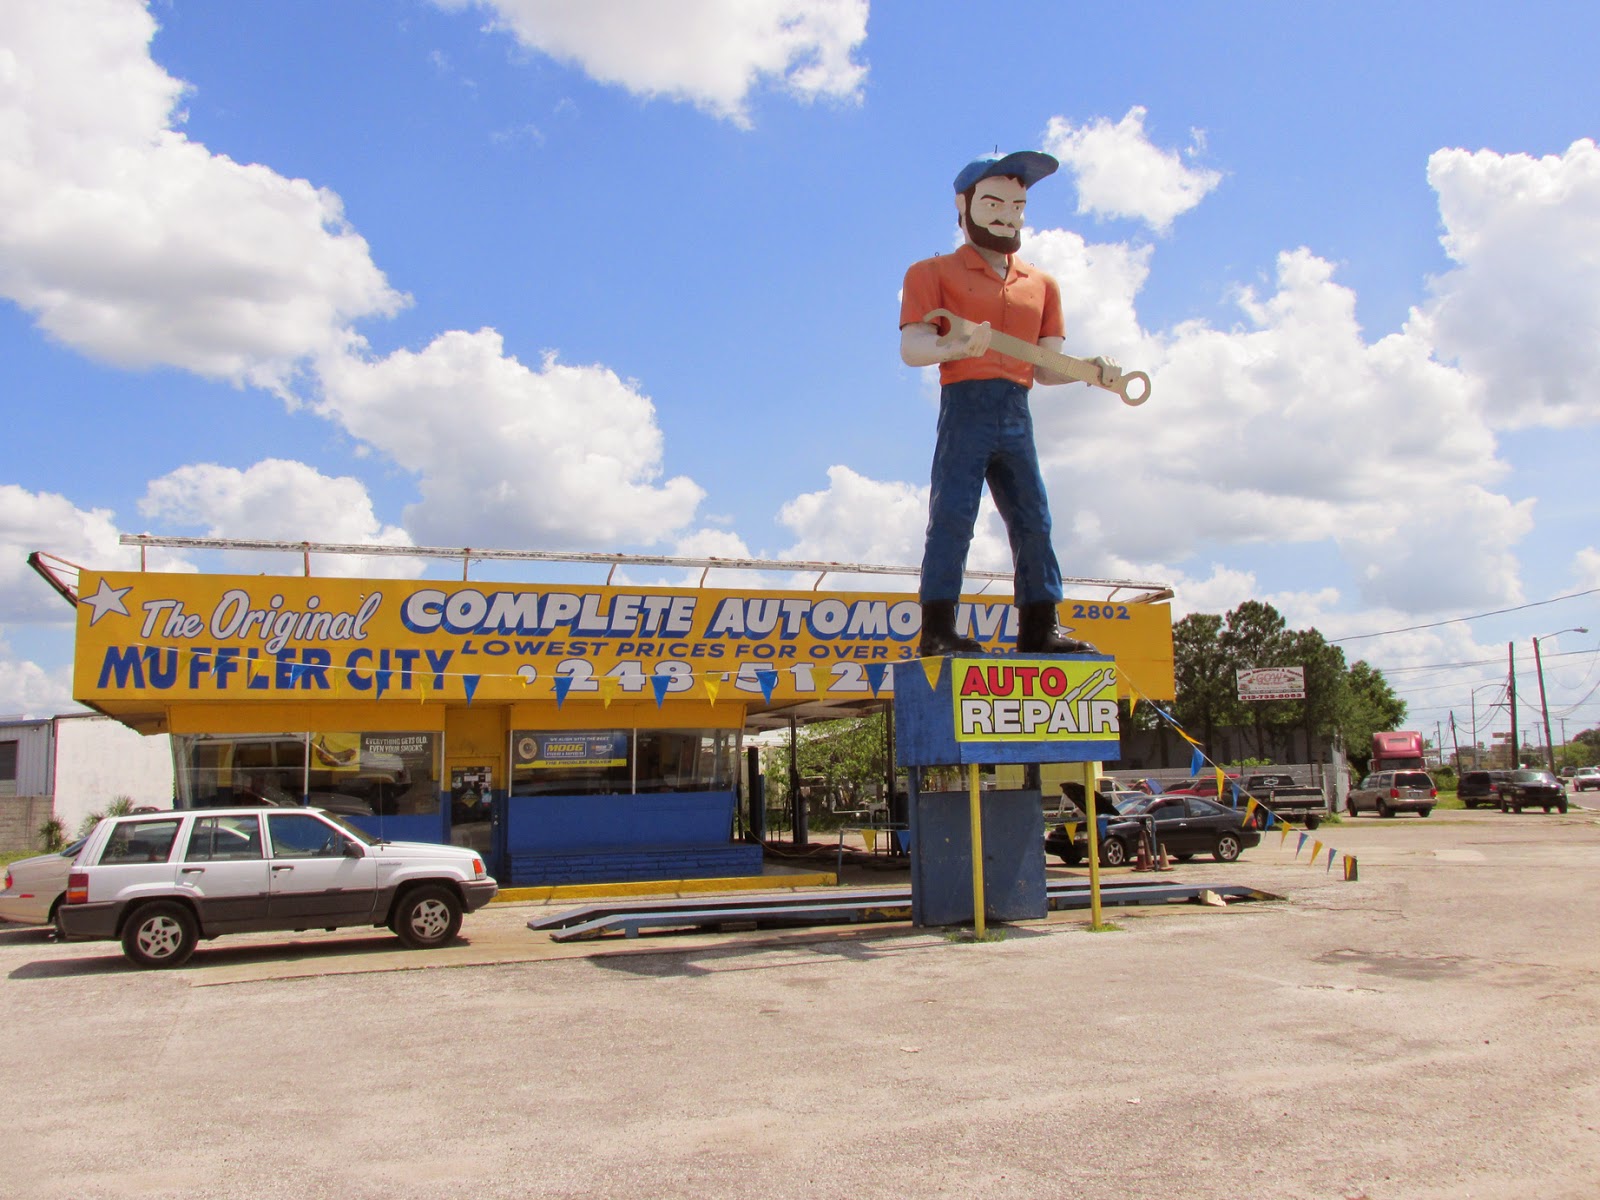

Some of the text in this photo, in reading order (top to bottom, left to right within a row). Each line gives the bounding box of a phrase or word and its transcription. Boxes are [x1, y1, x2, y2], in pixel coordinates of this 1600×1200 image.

[140, 589, 383, 654] The Original
[400, 588, 1131, 643] COMPLETE AUTOMOIVE 2802
[97, 646, 456, 691] MUFFLER CITY
[460, 640, 609, 656] LOWEST
[615, 642, 726, 658] PRICES
[734, 643, 797, 659] FOR
[808, 645, 889, 659] OVER
[960, 665, 1120, 735] AUTO REPAIR
[547, 743, 584, 752] MOOG
